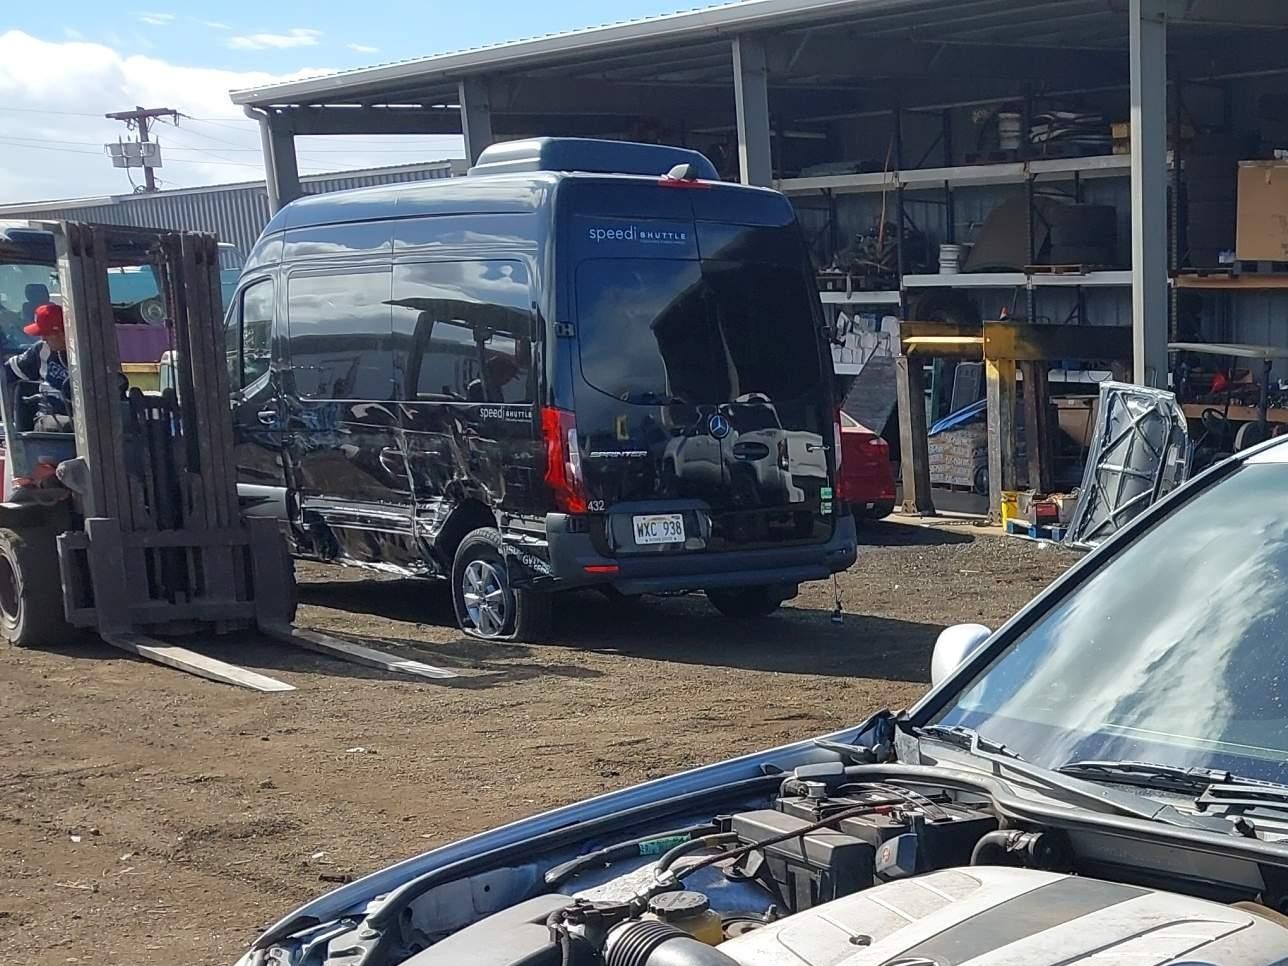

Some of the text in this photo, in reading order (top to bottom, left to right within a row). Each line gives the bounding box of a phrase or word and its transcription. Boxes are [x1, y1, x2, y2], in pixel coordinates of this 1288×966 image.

[589, 225, 637, 243] speedi
[639, 231, 686, 240] SHUTTLE
[479, 405, 505, 422] speedi
[587, 500, 605, 512] 432
[636, 520, 682, 538] WXC 938
